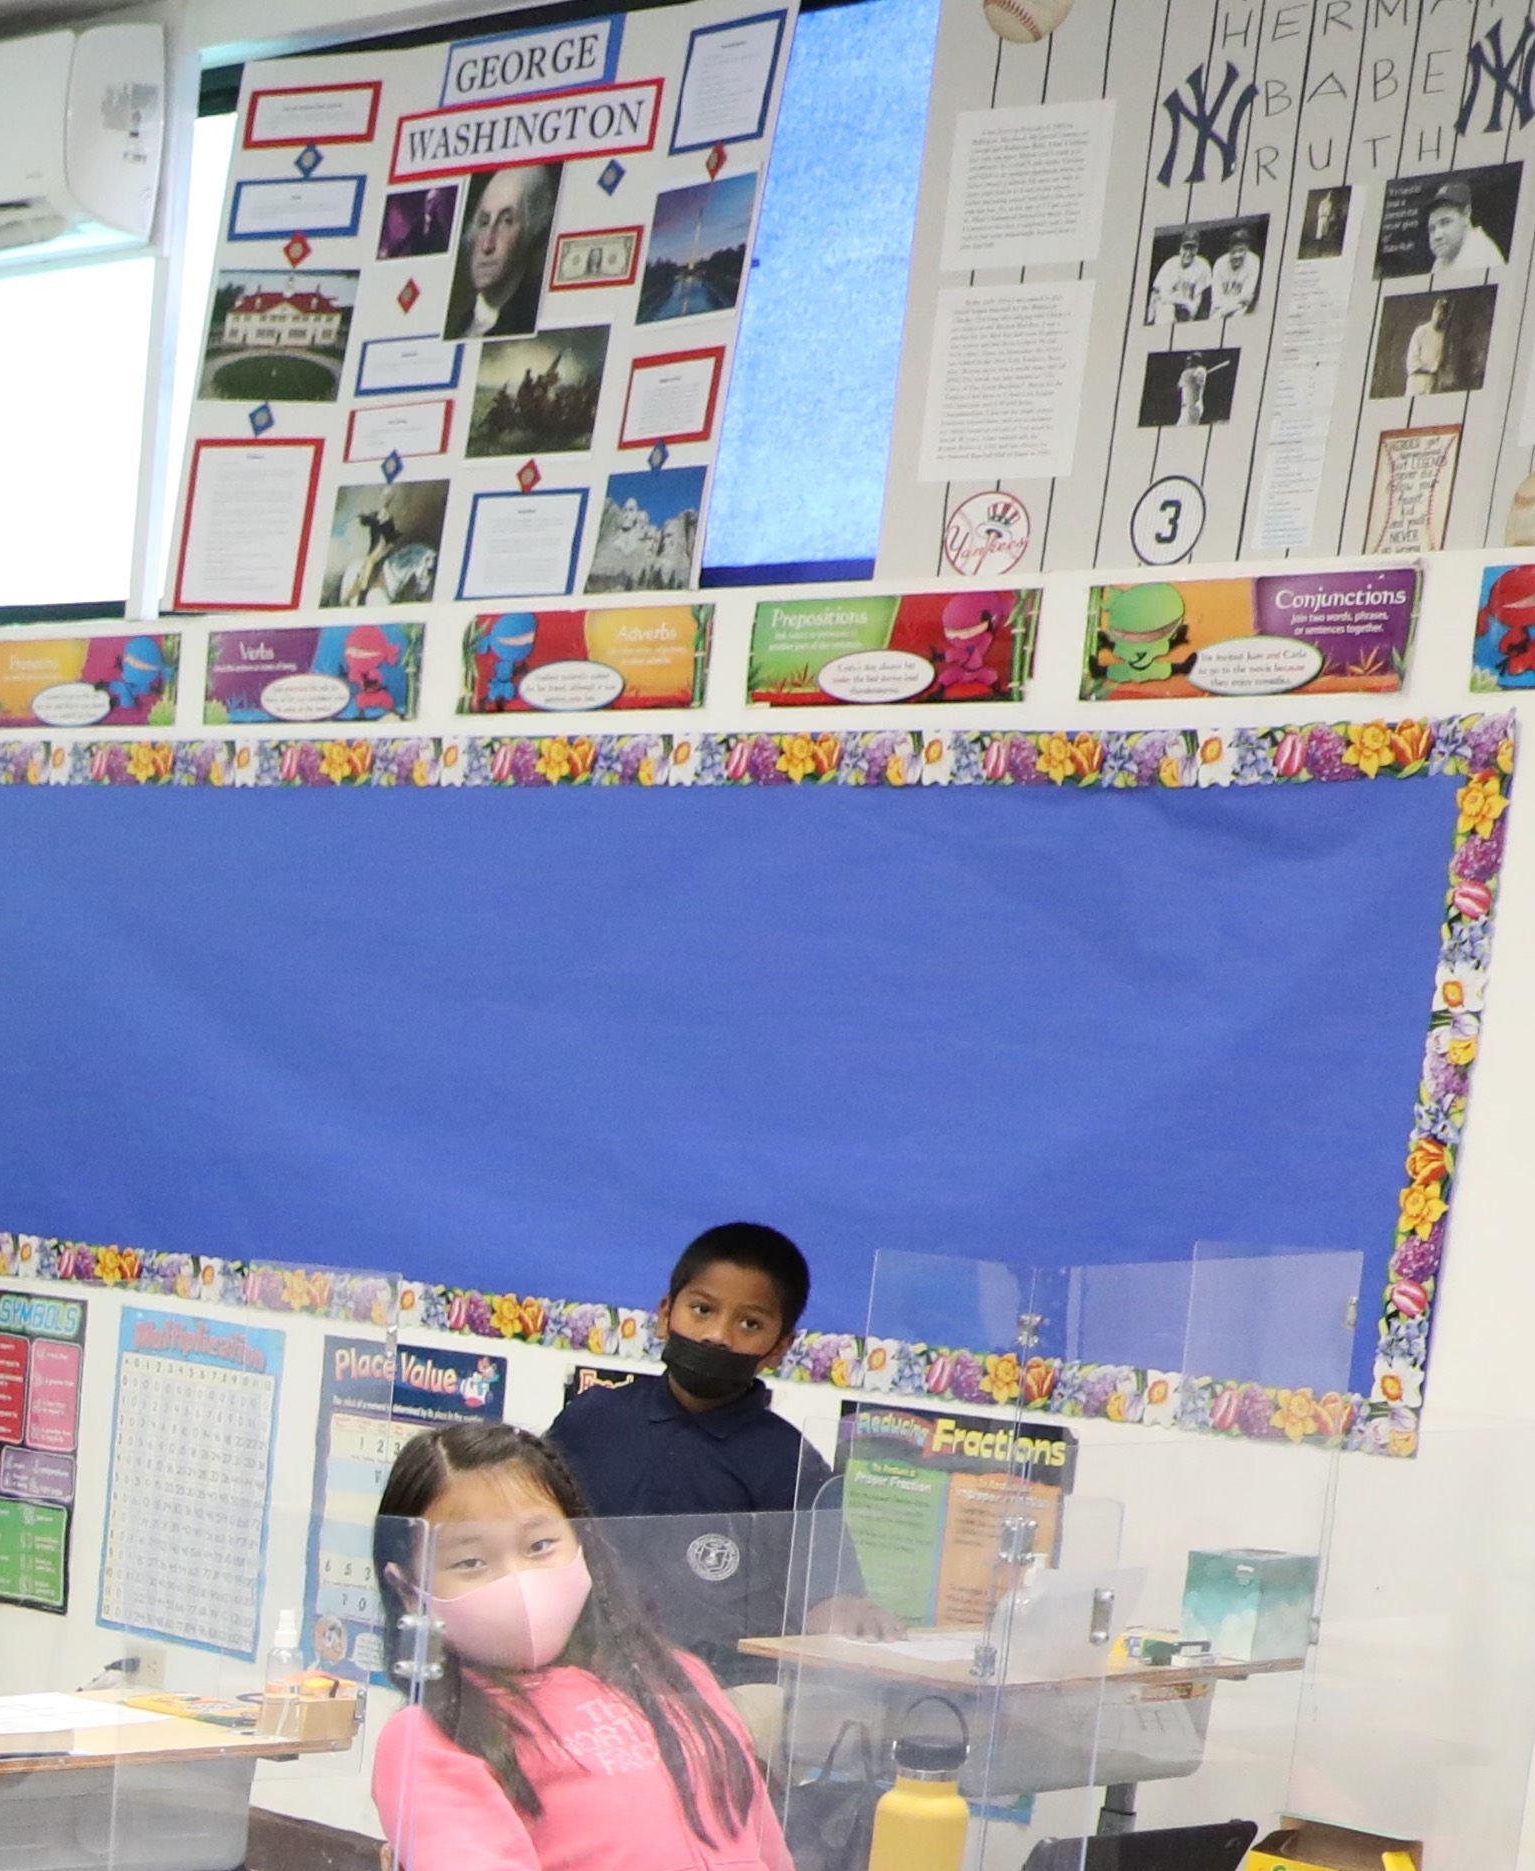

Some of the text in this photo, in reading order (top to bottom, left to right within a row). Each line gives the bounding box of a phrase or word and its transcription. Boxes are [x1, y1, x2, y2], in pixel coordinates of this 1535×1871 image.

[1222, 0, 1495, 48] HERM
[456, 34, 599, 93] GEORGE
[1264, 49, 1452, 117] BABE
[409, 100, 645, 161] WASHINGTON
[1255, 126, 1442, 186] RUTH
[1155, 500, 1182, 543] 3
[1275, 584, 1407, 612] Conjunctions
[617, 622, 677, 641] Adverbs
[771, 606, 868, 630] Prepositions
[1305, 625, 1345, 635] sentences
[1309, 614, 1325, 622] two
[240, 641, 275, 660] Verbs
[134, 1319, 267, 1373] Multiplication
[335, 1347, 459, 1394] Place Value
[361, 1437, 365, 1449] 1
[378, 1441, 384, 1453] 2
[858, 1412, 1066, 1466] Reducing Fractions
[345, 1563, 351, 1576] 5
[365, 1566, 371, 1580] 3
[359, 1597, 366, 1611] 0
